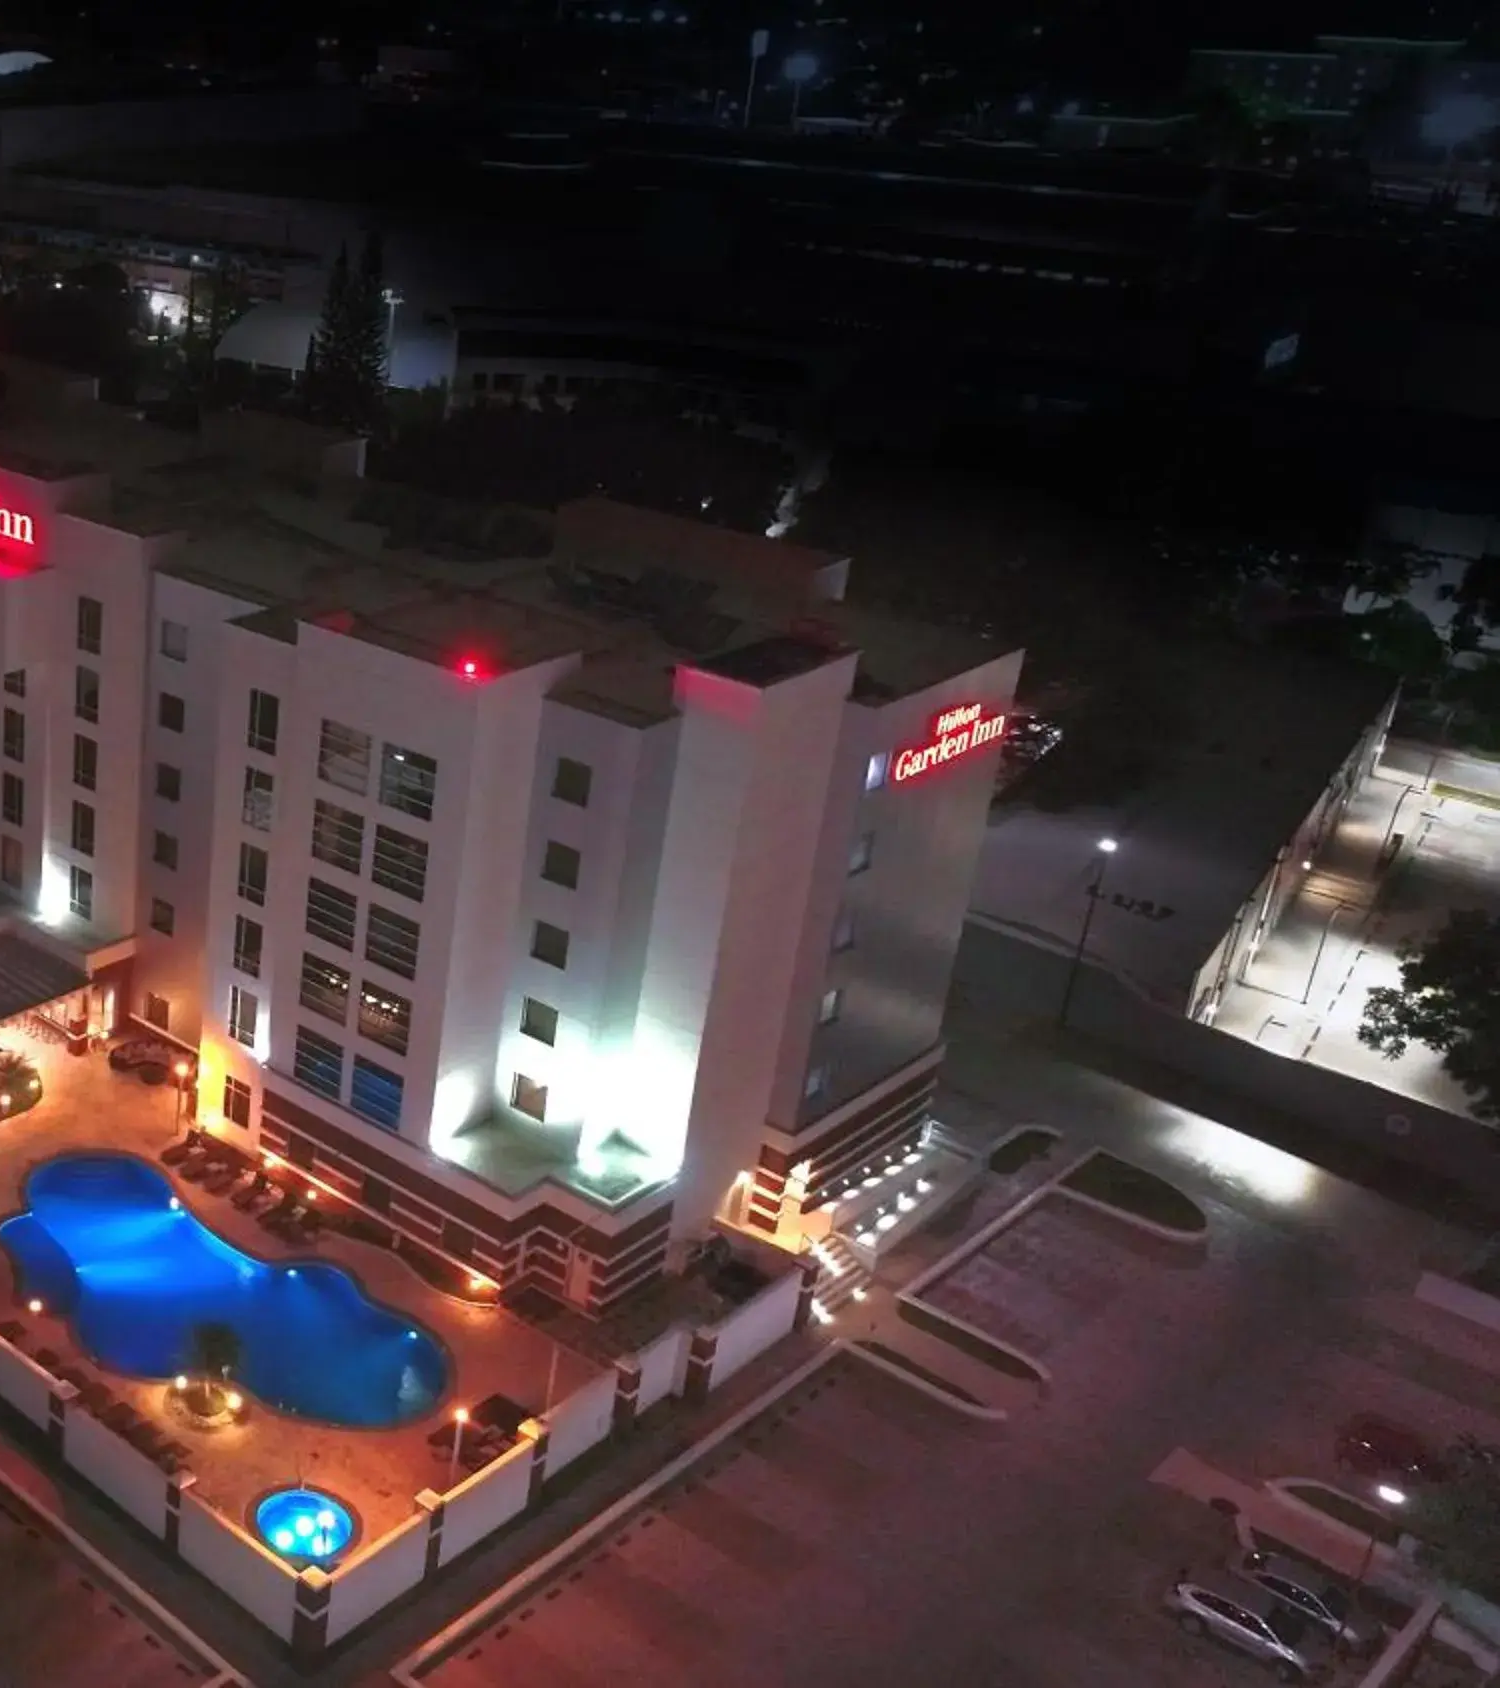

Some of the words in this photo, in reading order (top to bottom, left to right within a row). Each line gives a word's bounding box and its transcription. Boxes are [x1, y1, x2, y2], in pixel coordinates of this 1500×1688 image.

[936, 703, 981, 735] Hilton
[895, 731, 970, 781] Garden
[970, 715, 1005, 749] Inn
